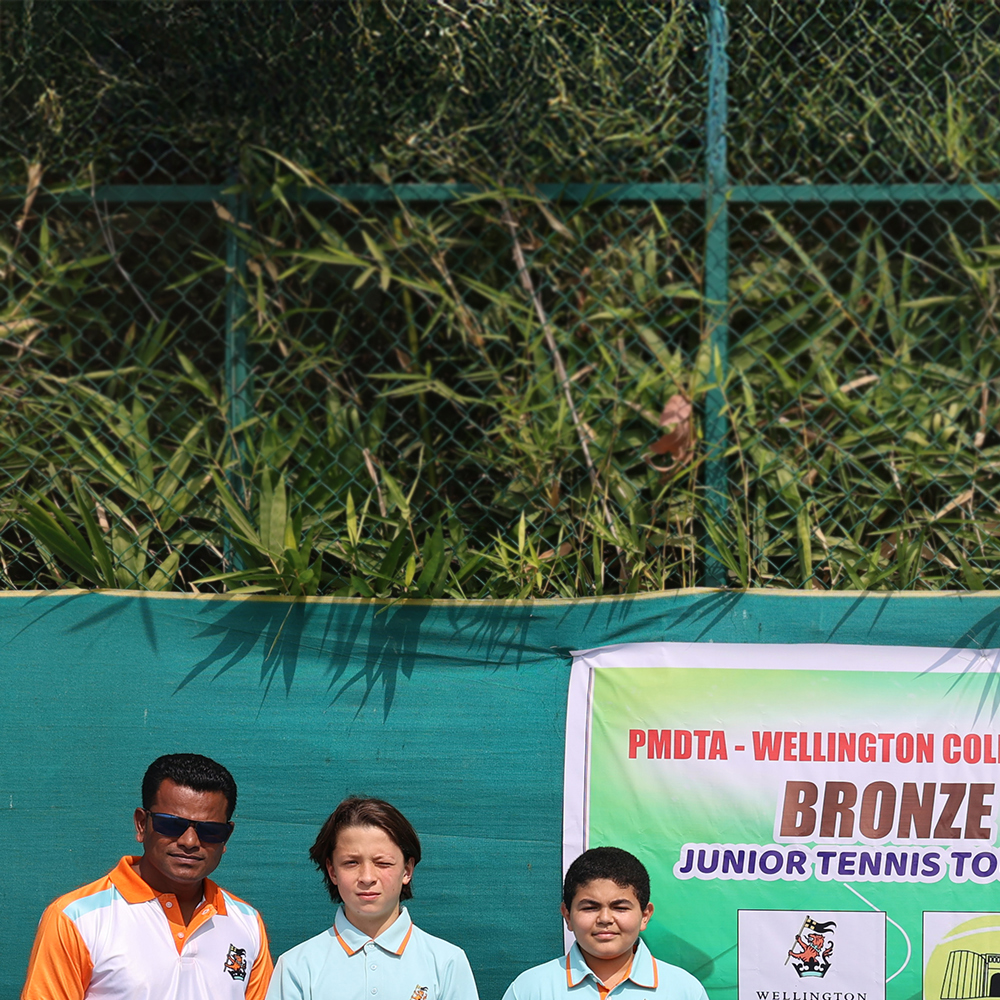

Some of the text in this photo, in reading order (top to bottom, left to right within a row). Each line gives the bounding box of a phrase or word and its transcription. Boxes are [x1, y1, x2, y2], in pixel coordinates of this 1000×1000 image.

[628, 729, 728, 760] PMDTA
[752, 731, 935, 764] WELLINGTON
[779, 780, 996, 840] BRONZE
[679, 848, 807, 876] JUNIOR
[816, 851, 941, 877] TENNIS
